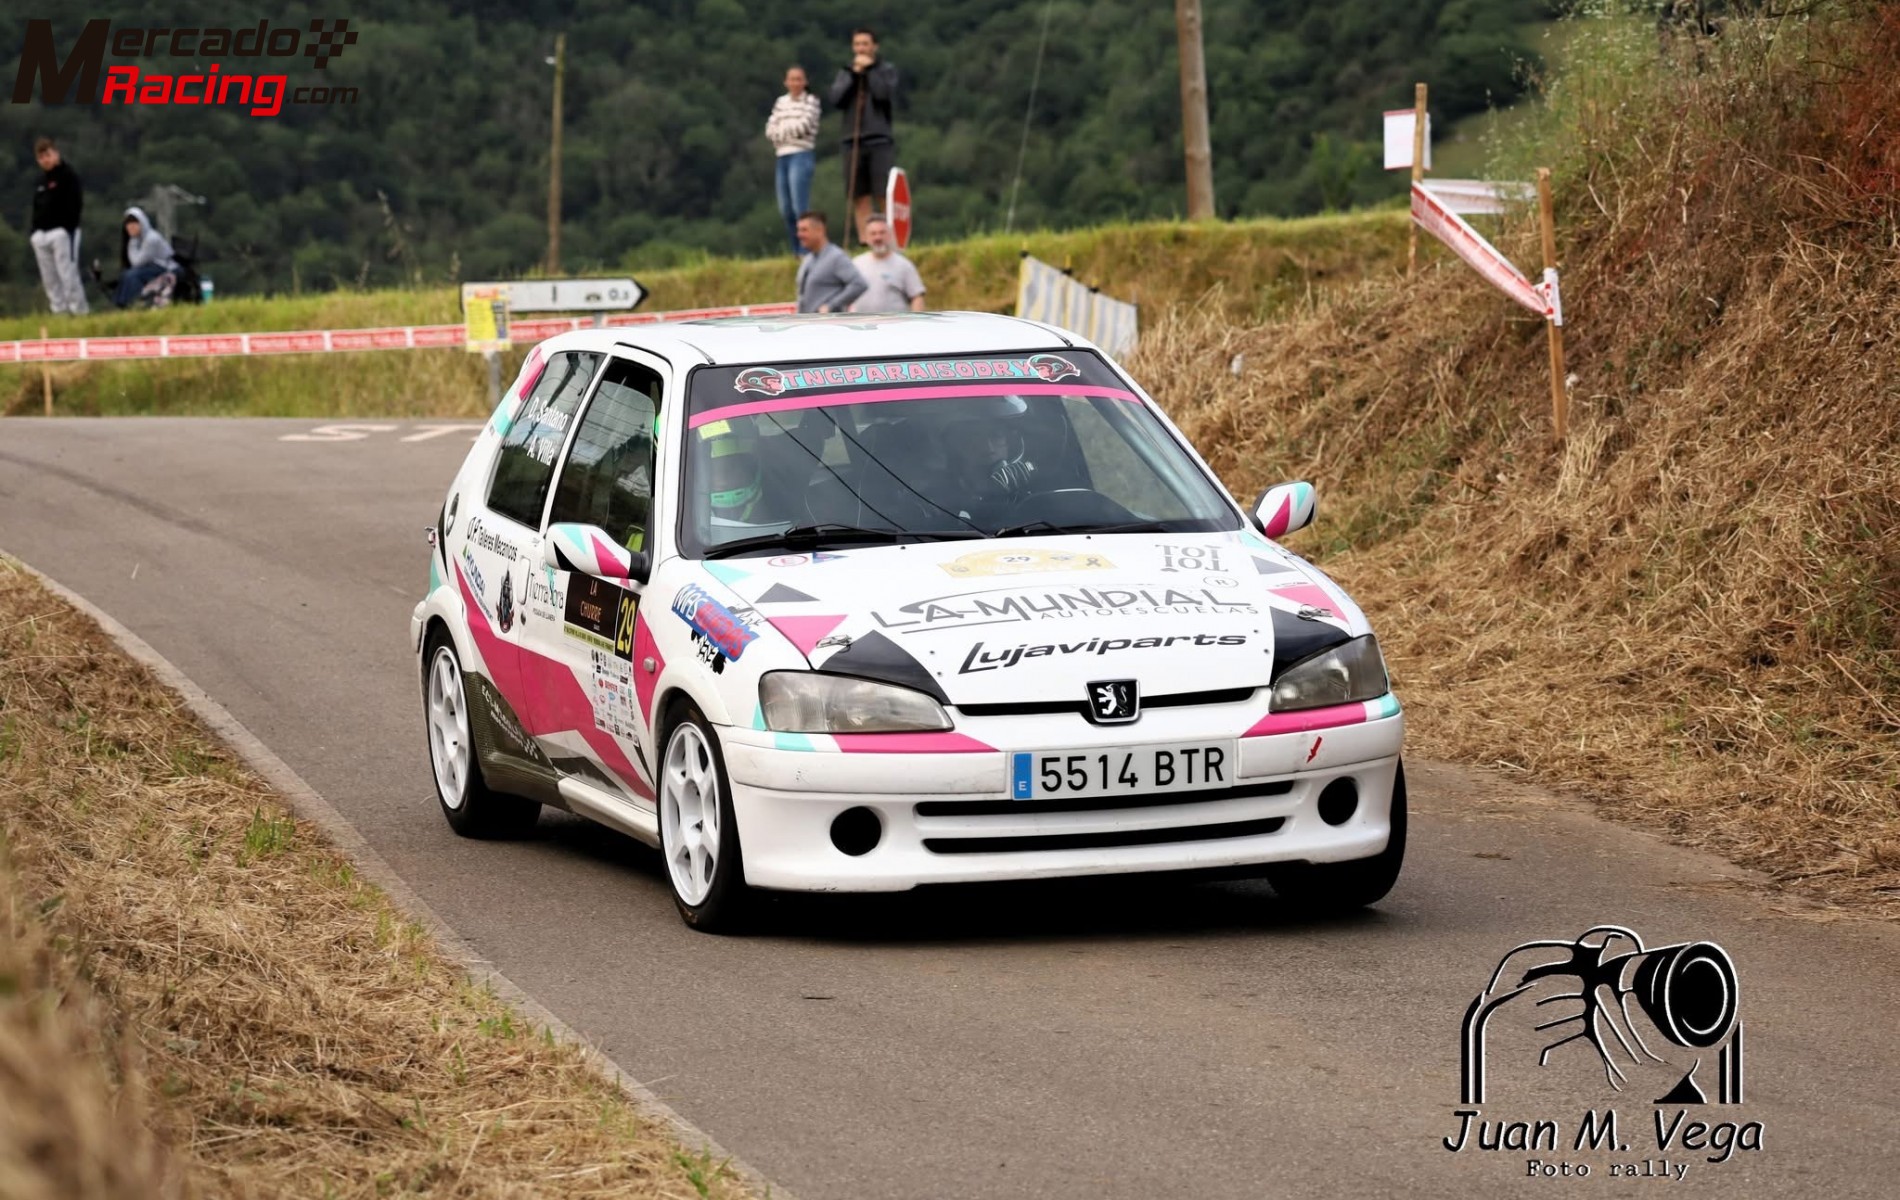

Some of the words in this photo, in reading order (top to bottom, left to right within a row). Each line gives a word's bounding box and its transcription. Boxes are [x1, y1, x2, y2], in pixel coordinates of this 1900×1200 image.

[783, 361, 1031, 387] TNCPARAISODRY
[617, 597, 636, 655] 29
[1040, 606, 1259, 620] AUTOESCUELAS
[958, 633, 1247, 675] Lujaviparts
[1018, 780, 1027, 791] E
[1041, 753, 1138, 792] 5514
[1155, 747, 1224, 786] BTR
